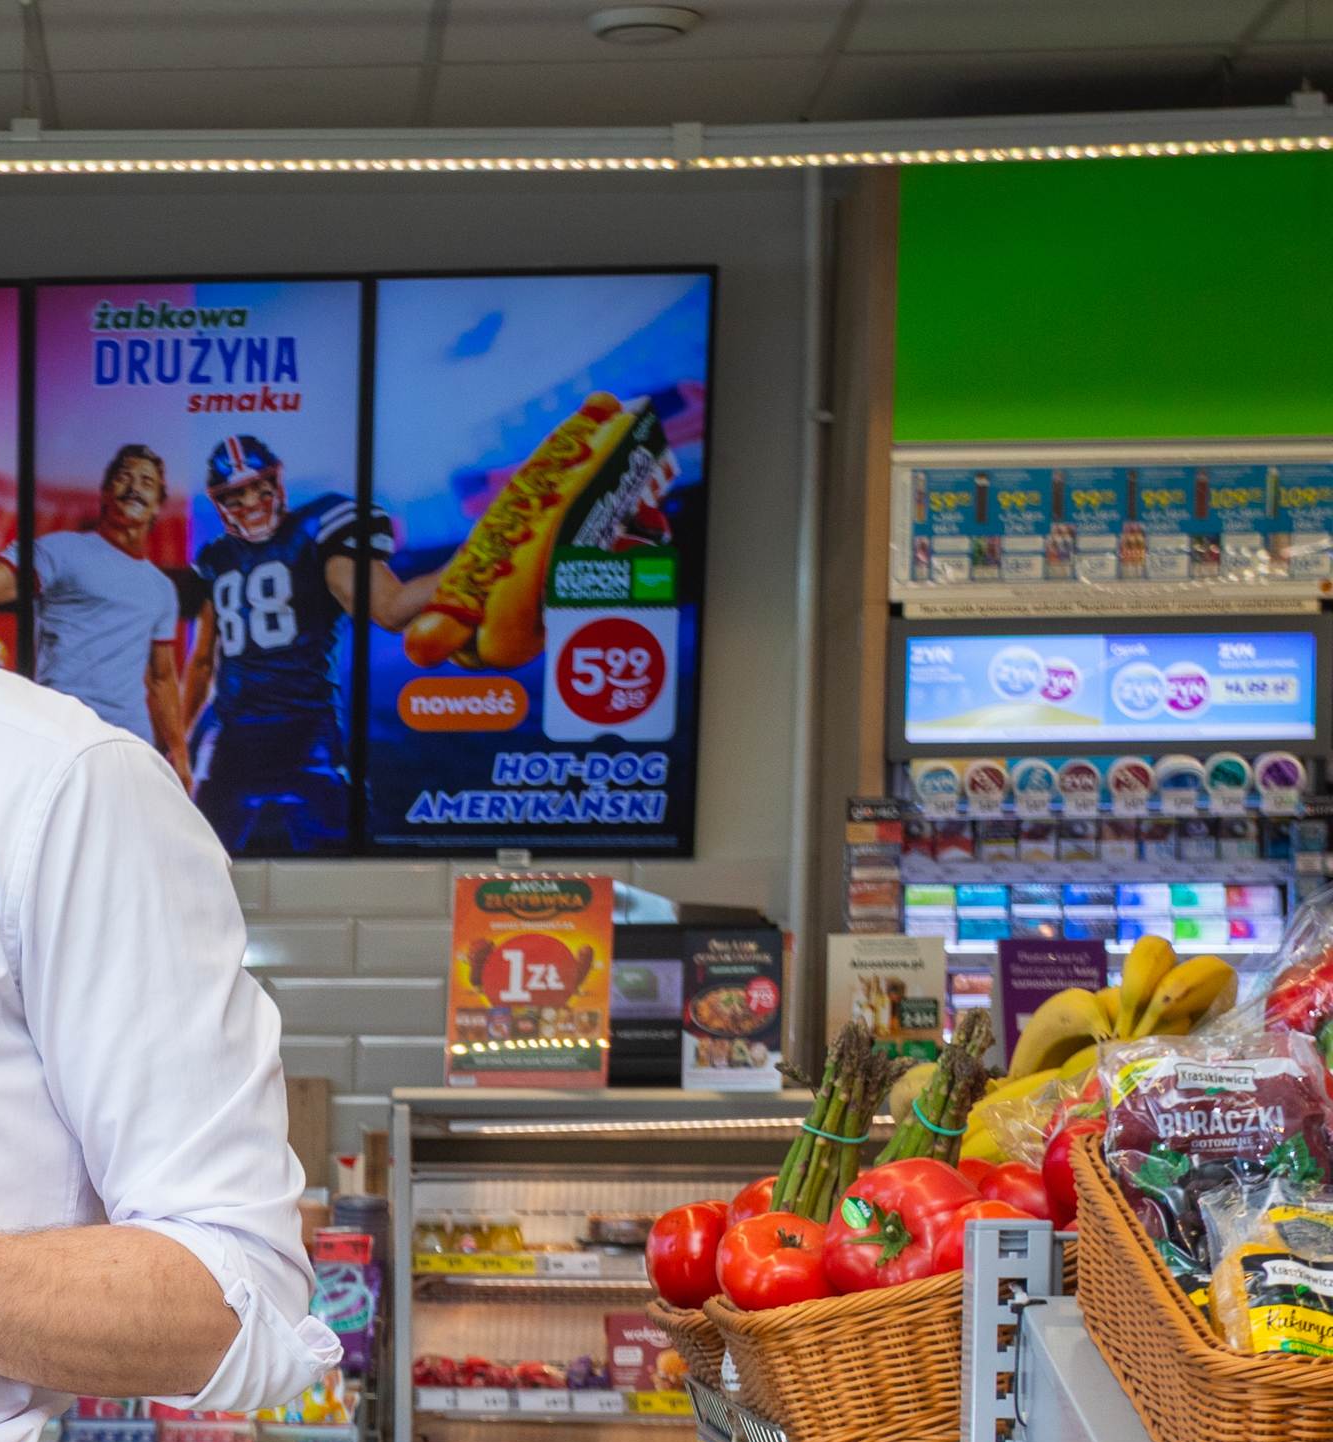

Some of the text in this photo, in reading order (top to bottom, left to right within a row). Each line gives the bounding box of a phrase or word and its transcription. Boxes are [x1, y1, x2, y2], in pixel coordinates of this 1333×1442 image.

[94, 301, 248, 330] żabkowa
[95, 330, 298, 385] DRUŻYNA
[187, 386, 302, 413] smaku
[213, 560, 298, 657] 88
[409, 689, 517, 716] nowość
[492, 752, 669, 786] HOT-DOG
[405, 783, 669, 823] AMERYKAŃSKI
[499, 949, 532, 1003] 1
[1179, 1069, 1250, 1086] Kraszkiewicz
[1156, 1105, 1285, 1139] BURACZKI
[1191, 1135, 1255, 1149] GOTOWANE
